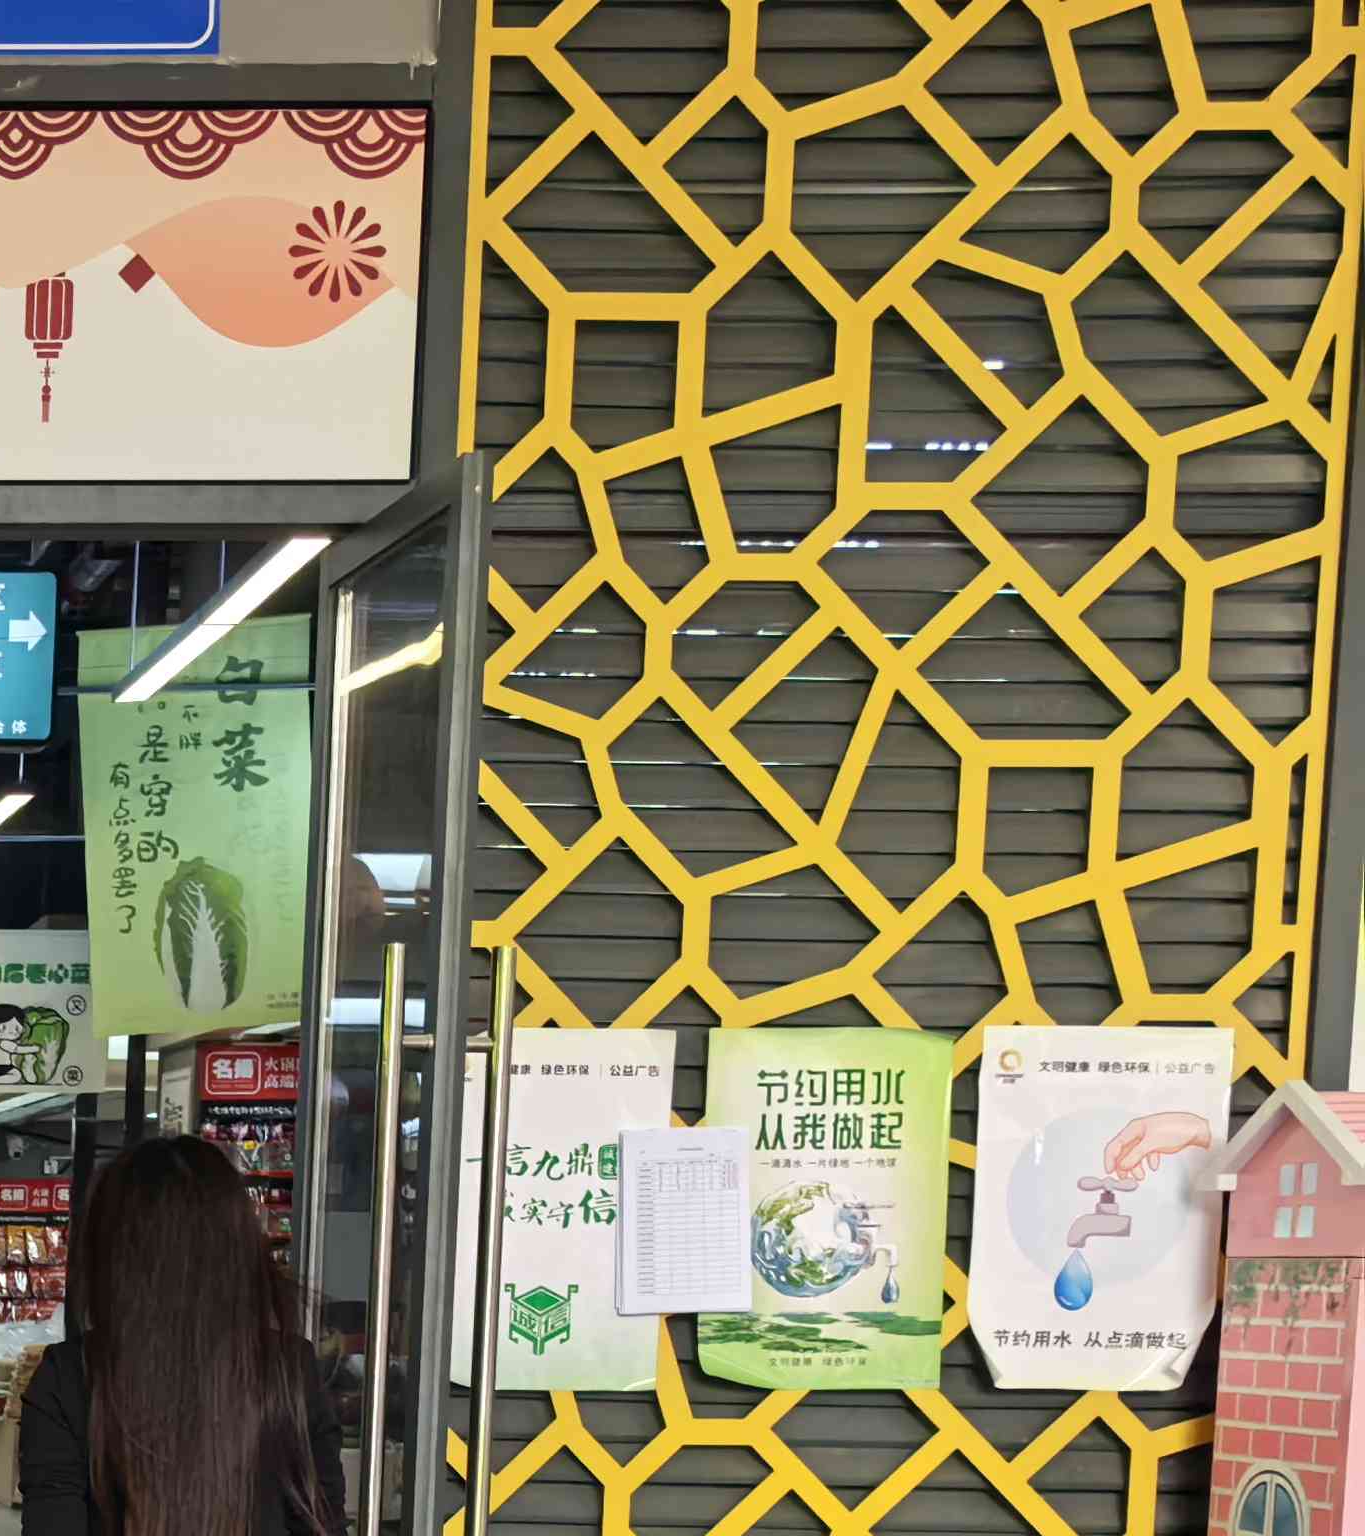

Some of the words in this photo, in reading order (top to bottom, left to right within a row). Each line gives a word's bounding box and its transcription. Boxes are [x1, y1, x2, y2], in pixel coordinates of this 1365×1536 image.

[541, 1064, 590, 1076] 绿色环保
[610, 1064, 660, 1078] 公益广告
[1038, 1061, 1090, 1073] 文明健康
[757, 1068, 906, 1108] 节约用水
[755, 1112, 903, 1151] 从我做起
[994, 1330, 1072, 1348] 节约用水
[1084, 1331, 1188, 1350] 从点滴做起
